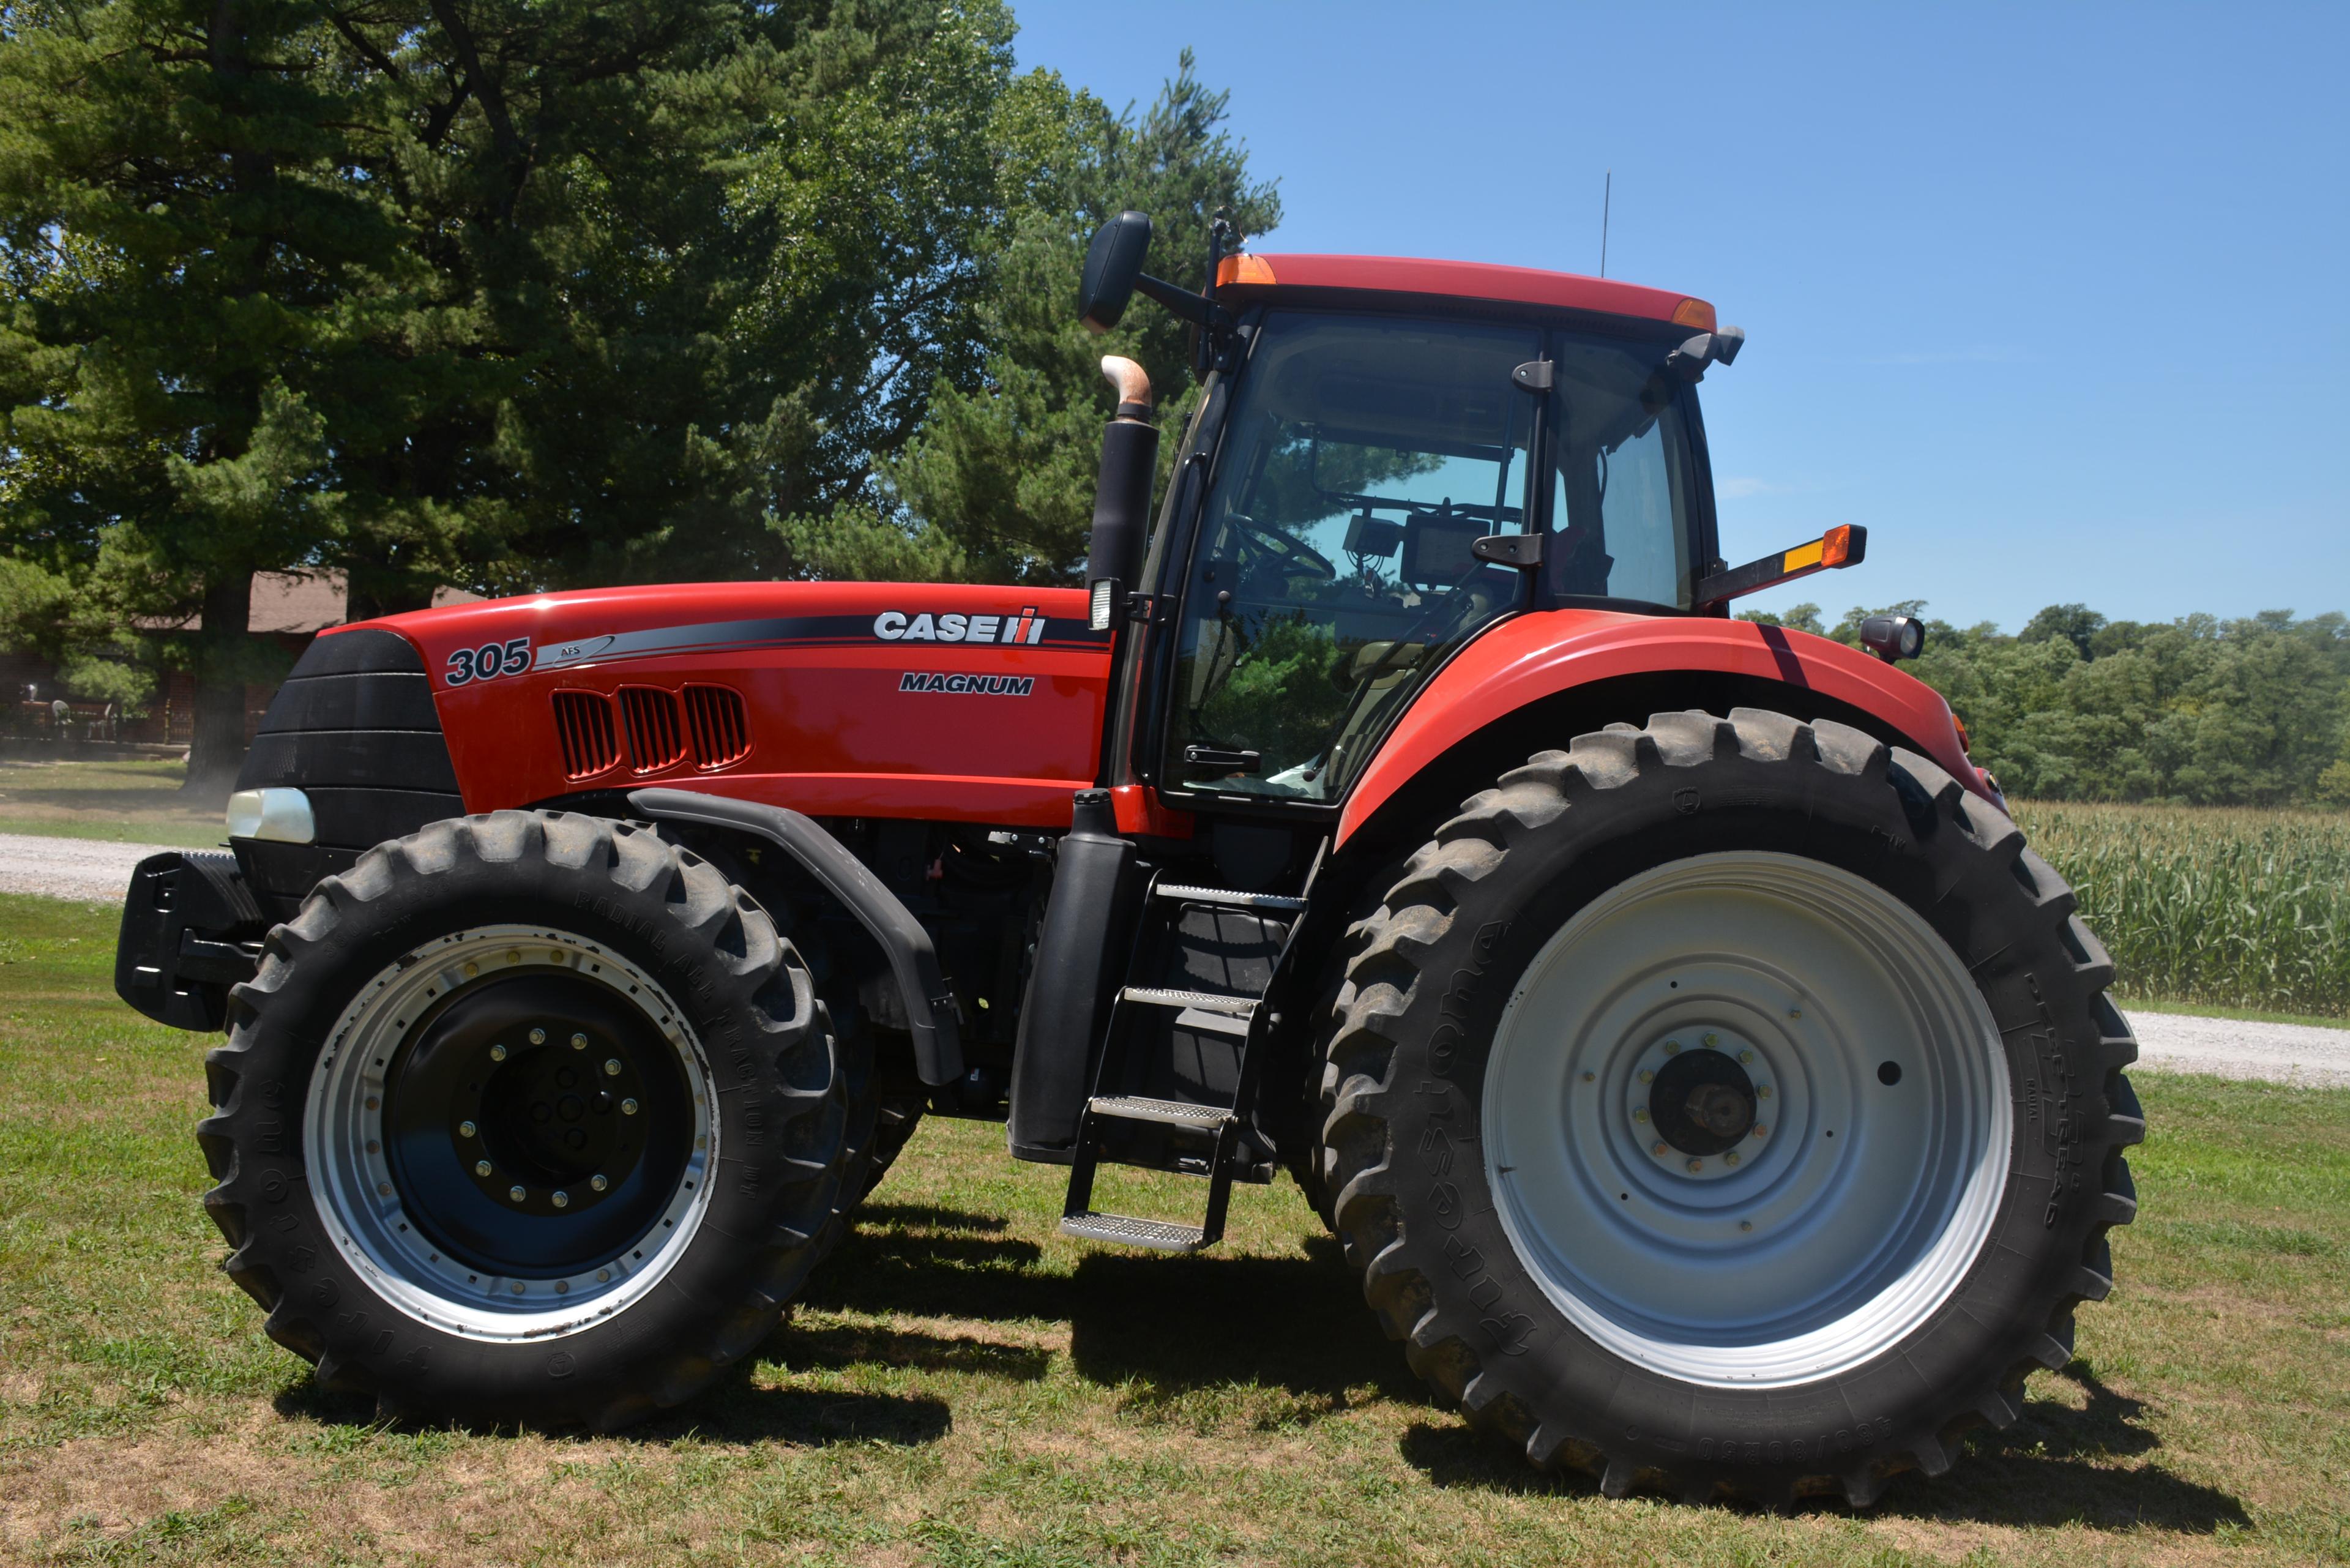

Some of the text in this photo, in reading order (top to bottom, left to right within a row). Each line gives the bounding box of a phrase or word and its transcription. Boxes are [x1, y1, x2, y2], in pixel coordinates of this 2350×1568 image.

[560, 645, 581, 656] AFS
[873, 610, 1001, 643] CASE
[445, 636, 531, 686] 305
[898, 672, 1035, 696] MAGNUM
[573, 889, 667, 953] RADIAL
[673, 952, 716, 1002] ALL
[717, 1008, 765, 1148] TRACTION
[2026, 1077, 2039, 1124] RADIAL
[1413, 920, 1539, 1357] Firestone
[2042, 1089, 2070, 1230] TREAD
[254, 1078, 435, 1378] Firestone
